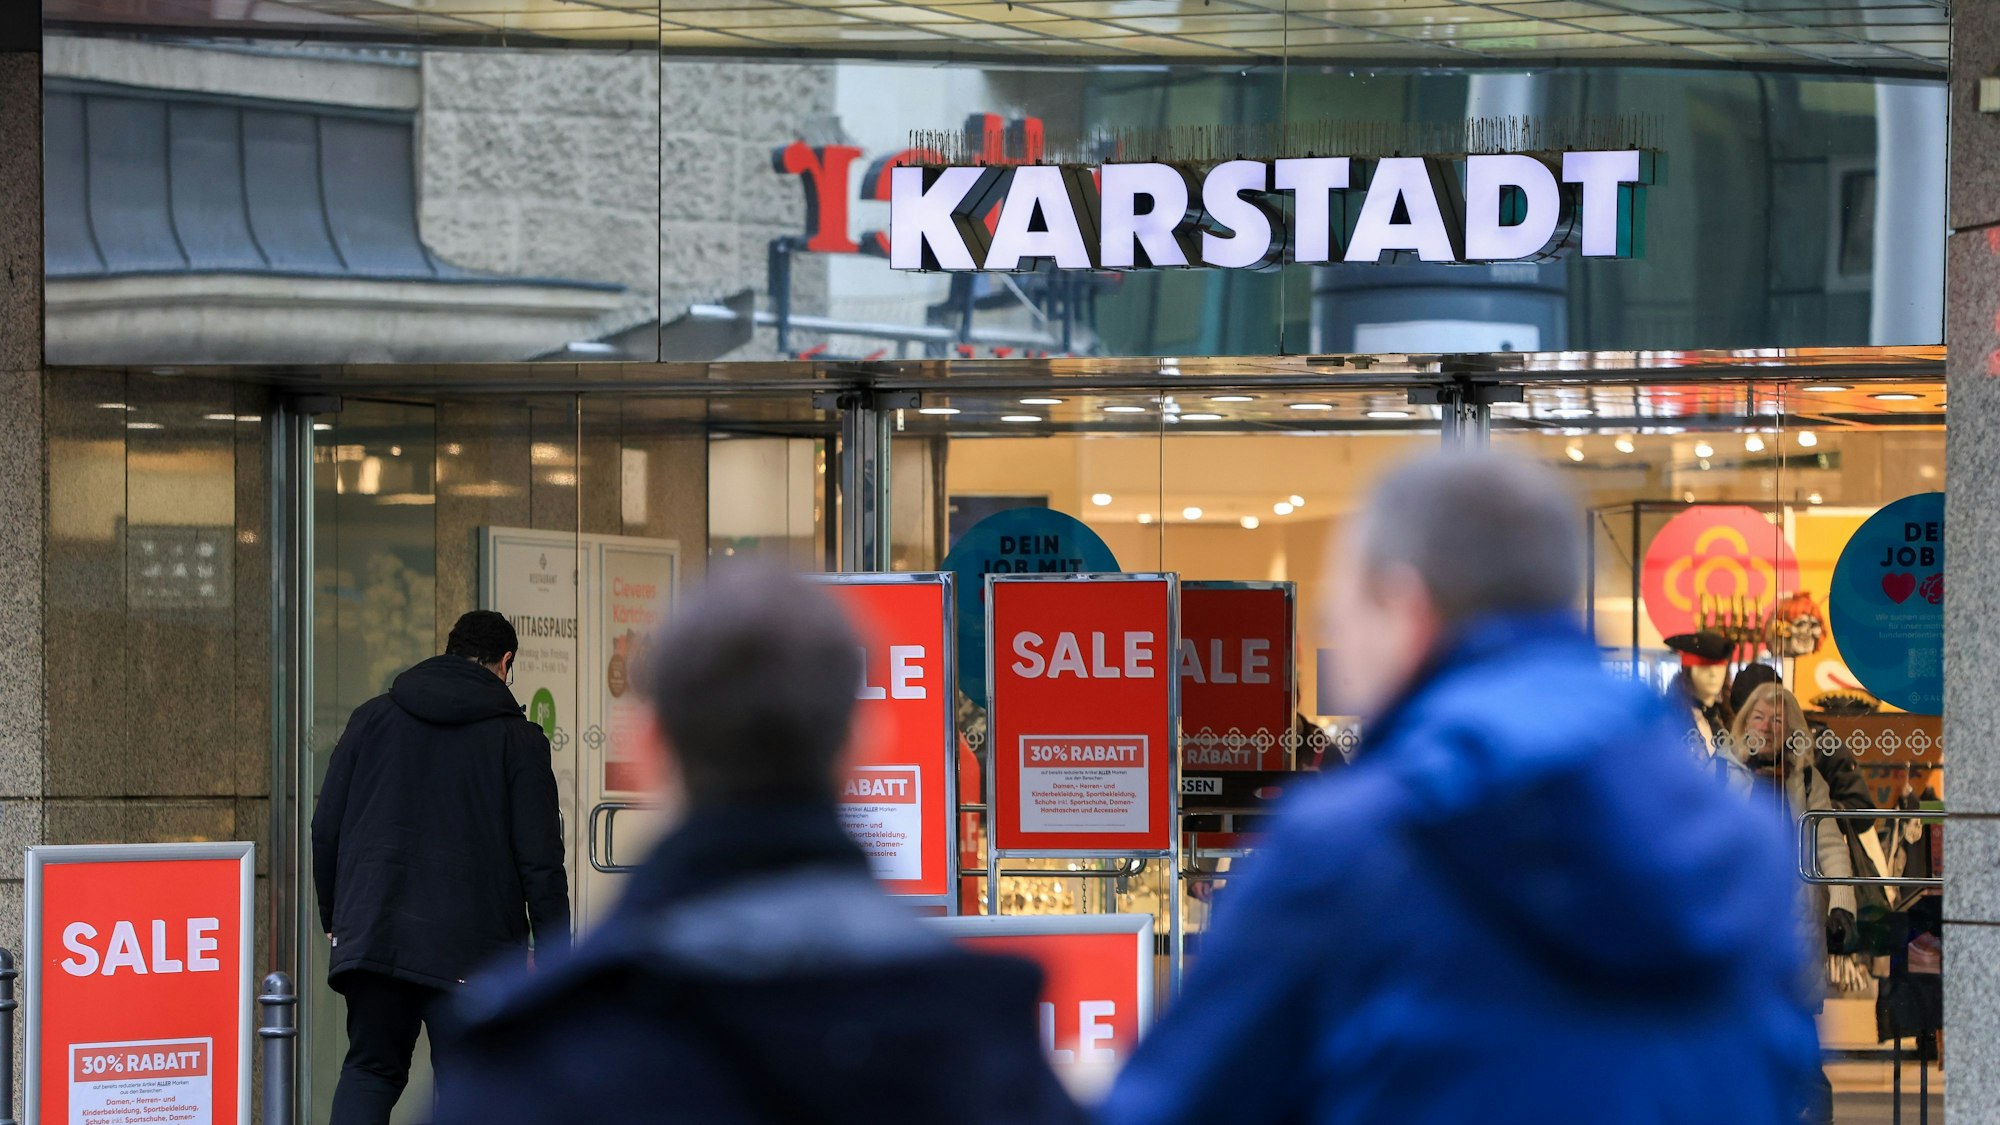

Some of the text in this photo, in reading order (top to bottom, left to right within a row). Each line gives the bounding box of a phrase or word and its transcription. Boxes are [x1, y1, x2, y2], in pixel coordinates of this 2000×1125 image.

[890, 149, 1640, 270] KARSTADT
[1000, 535, 1060, 554] DEIN
[1038, 559, 1082, 573] MIT
[1880, 546, 1935, 567] JOB
[1011, 631, 1154, 679] SALE
[1180, 638, 1271, 684] ALE
[853, 644, 927, 700] LE
[1030, 744, 1138, 762] 30% RABATT
[1187, 749, 1251, 764] RABATT
[842, 778, 908, 797] ABATT
[864, 849, 897, 857] cessoires
[60, 917, 220, 978] SALE
[1039, 1000, 1116, 1064] LE
[81, 1050, 201, 1075] 30% RABATT
[82, 1104, 199, 1116] Kinderbekleidung, Sportbekleidung,
[125, 1115, 168, 1124] Sportschuhe,
